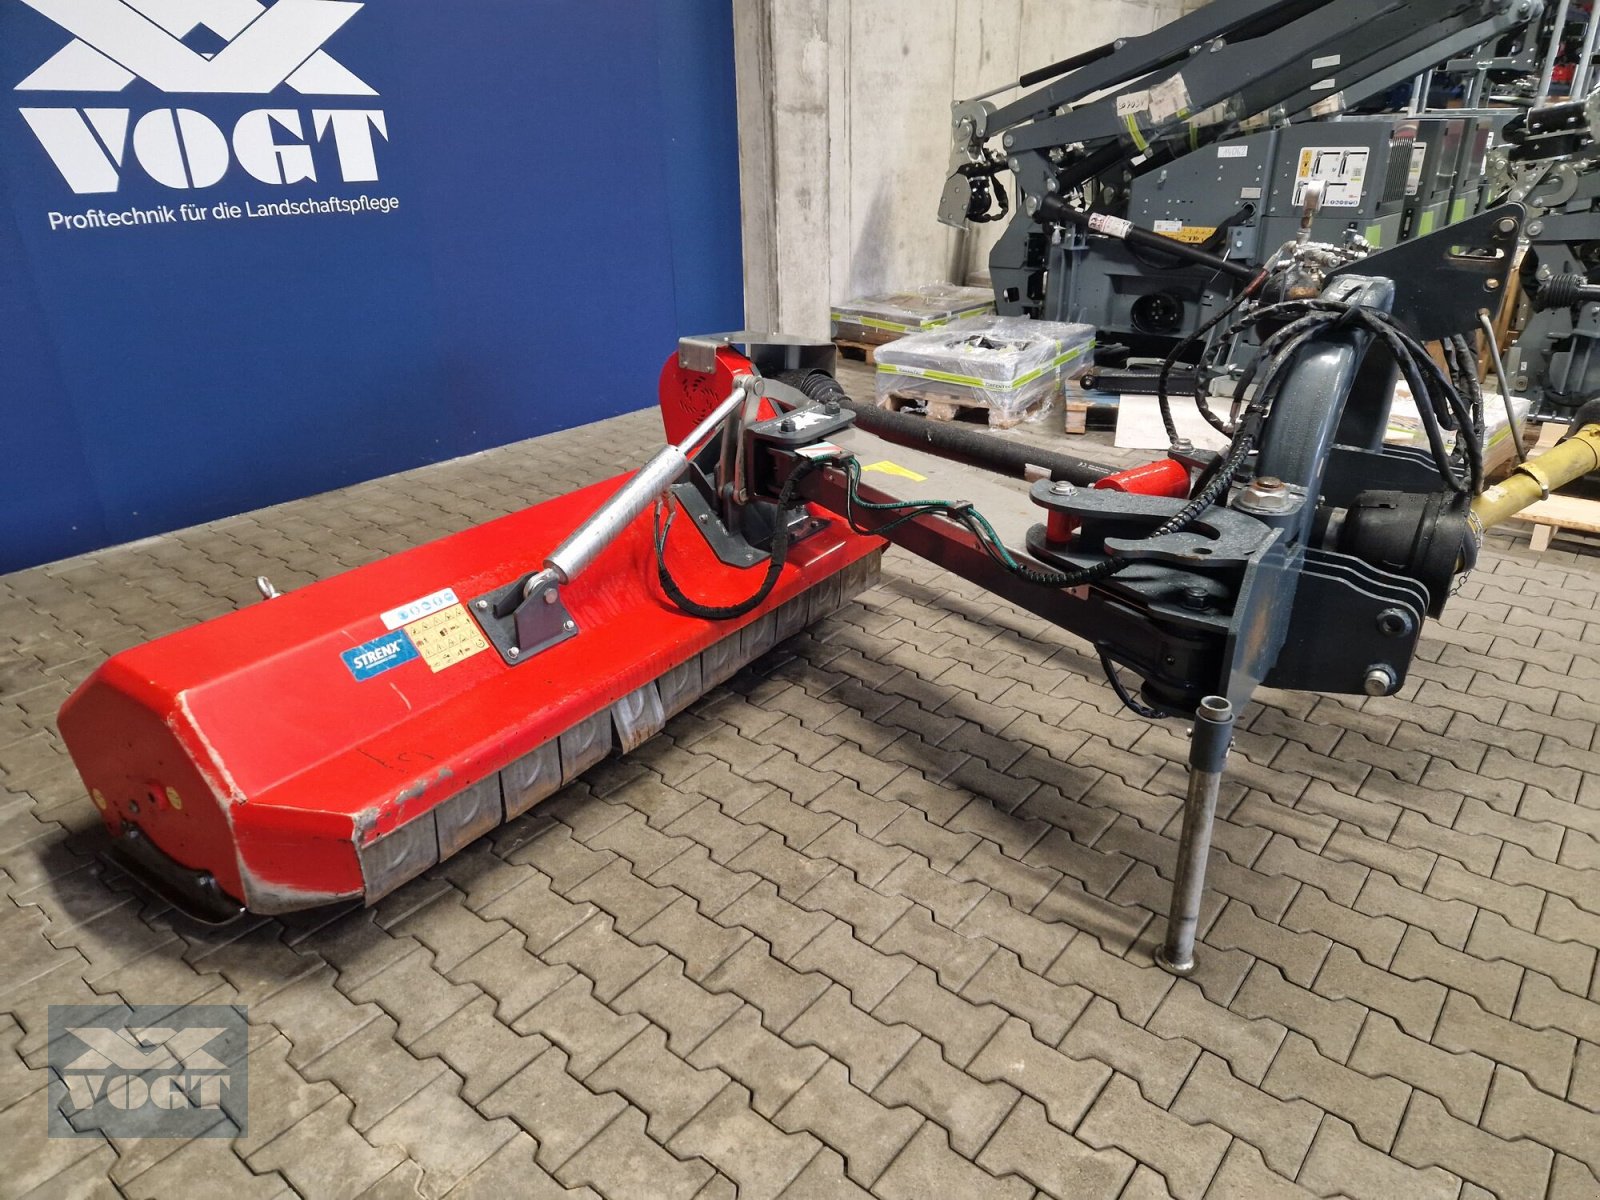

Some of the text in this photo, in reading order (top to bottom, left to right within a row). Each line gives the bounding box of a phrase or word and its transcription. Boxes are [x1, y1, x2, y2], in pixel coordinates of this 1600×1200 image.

[18, 107, 390, 194] VOGT
[48, 195, 400, 230] Profitechnik für die Landschaftspflege
[353, 641, 401, 669] STRENX
